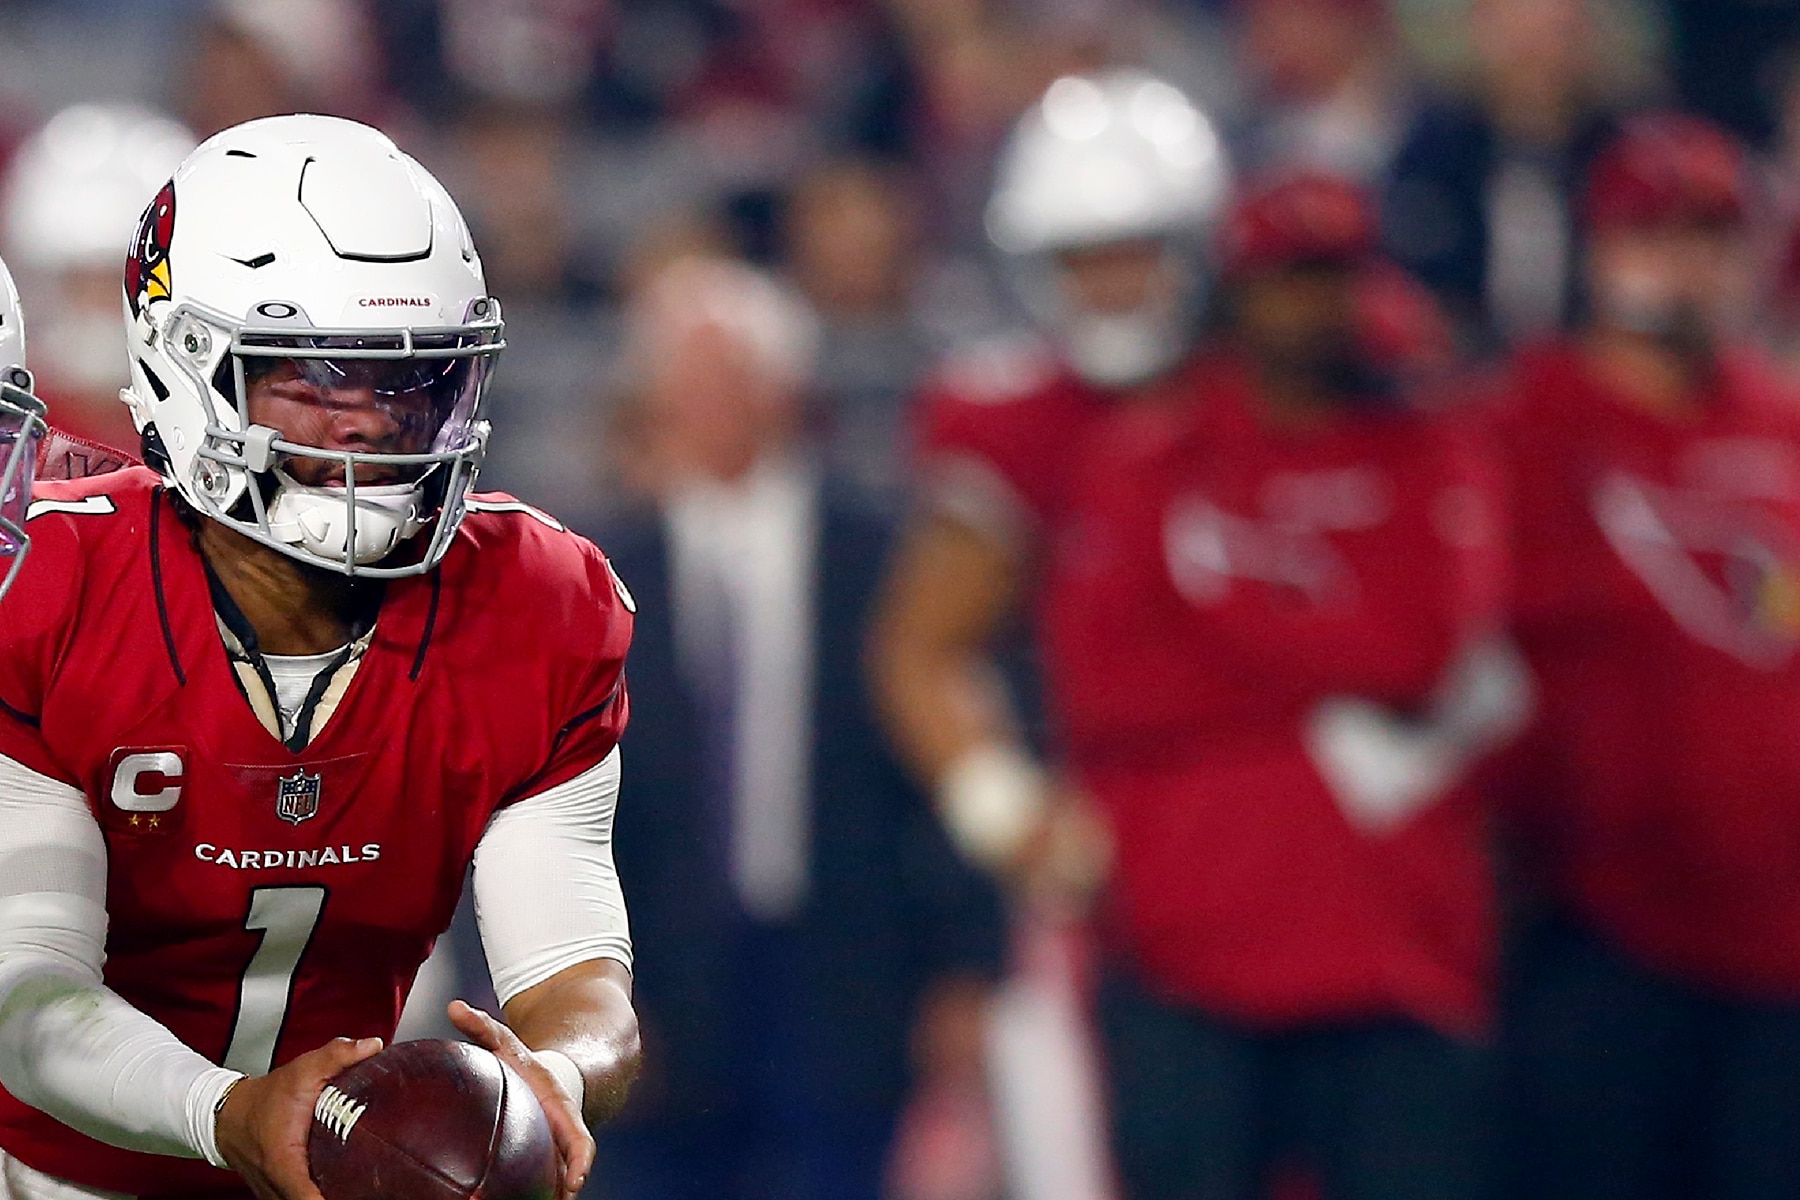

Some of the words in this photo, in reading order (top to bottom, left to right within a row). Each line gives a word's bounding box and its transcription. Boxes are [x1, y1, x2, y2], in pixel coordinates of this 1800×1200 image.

[358, 297, 431, 307] CARDINALS
[110, 751, 184, 813] C
[283, 794, 314, 815] NFL
[195, 842, 382, 870] CARDINALS
[222, 883, 329, 1080] 1
